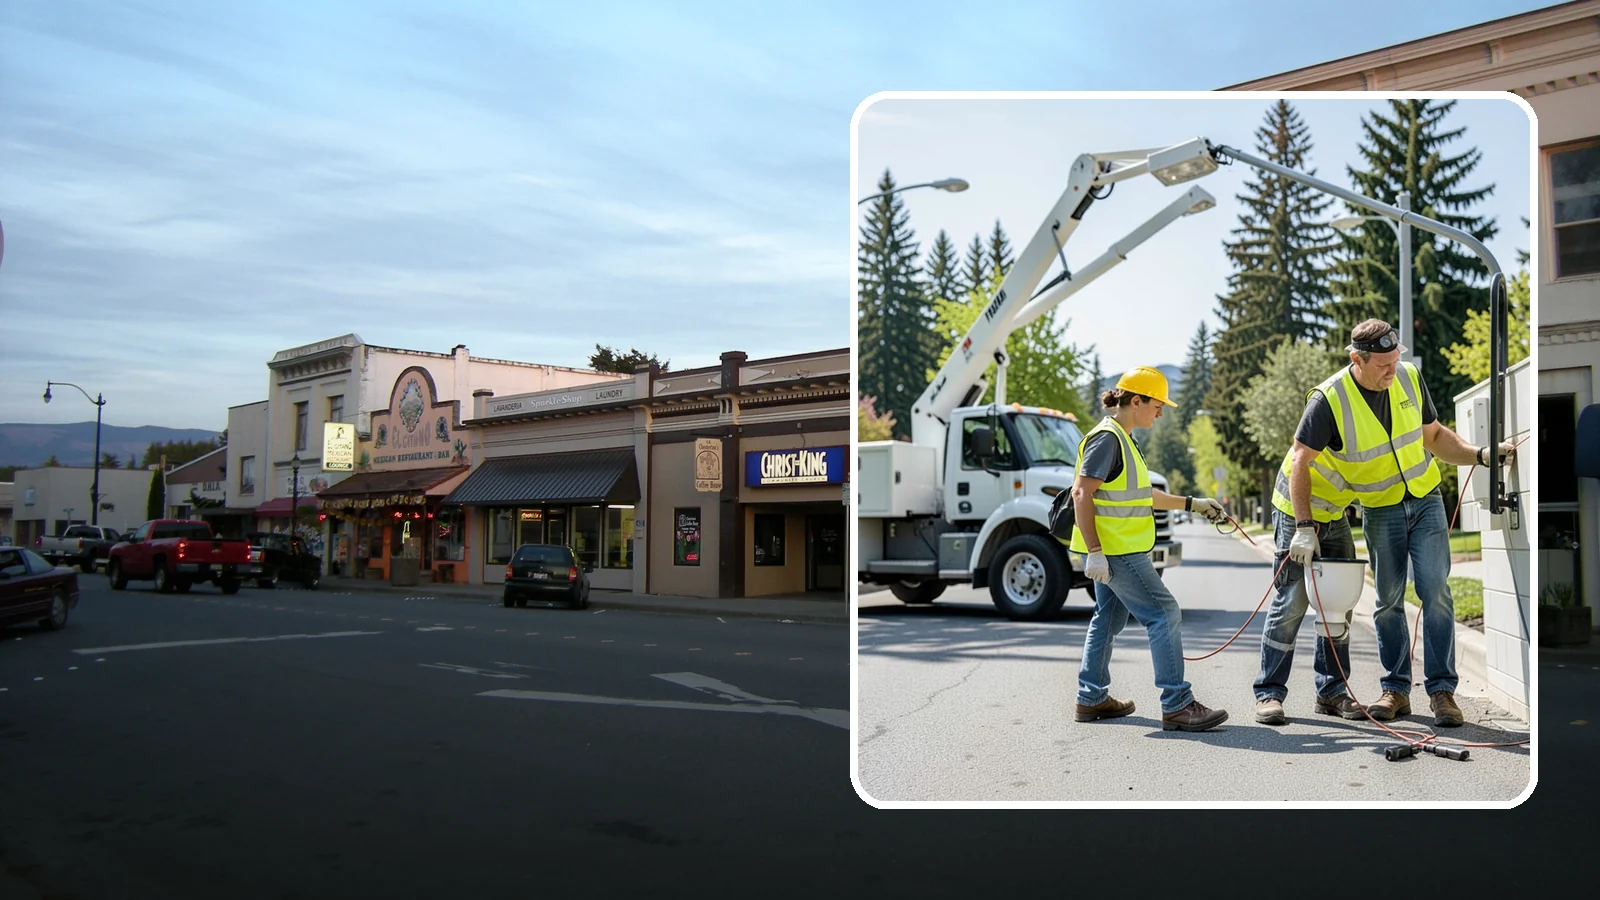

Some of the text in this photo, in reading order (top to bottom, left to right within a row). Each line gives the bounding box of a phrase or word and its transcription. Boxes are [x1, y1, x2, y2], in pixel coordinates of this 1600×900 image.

[561, 394, 582, 405] Shop
[595, 389, 623, 399] LAUNDRY
[493, 402, 522, 412] LAVANDERIA
[373, 454, 396, 464] MEXICAN
[398, 451, 433, 462] RESTAURANT
[438, 450, 450, 459] BAR
[761, 450, 827, 477] CHRIST KING
